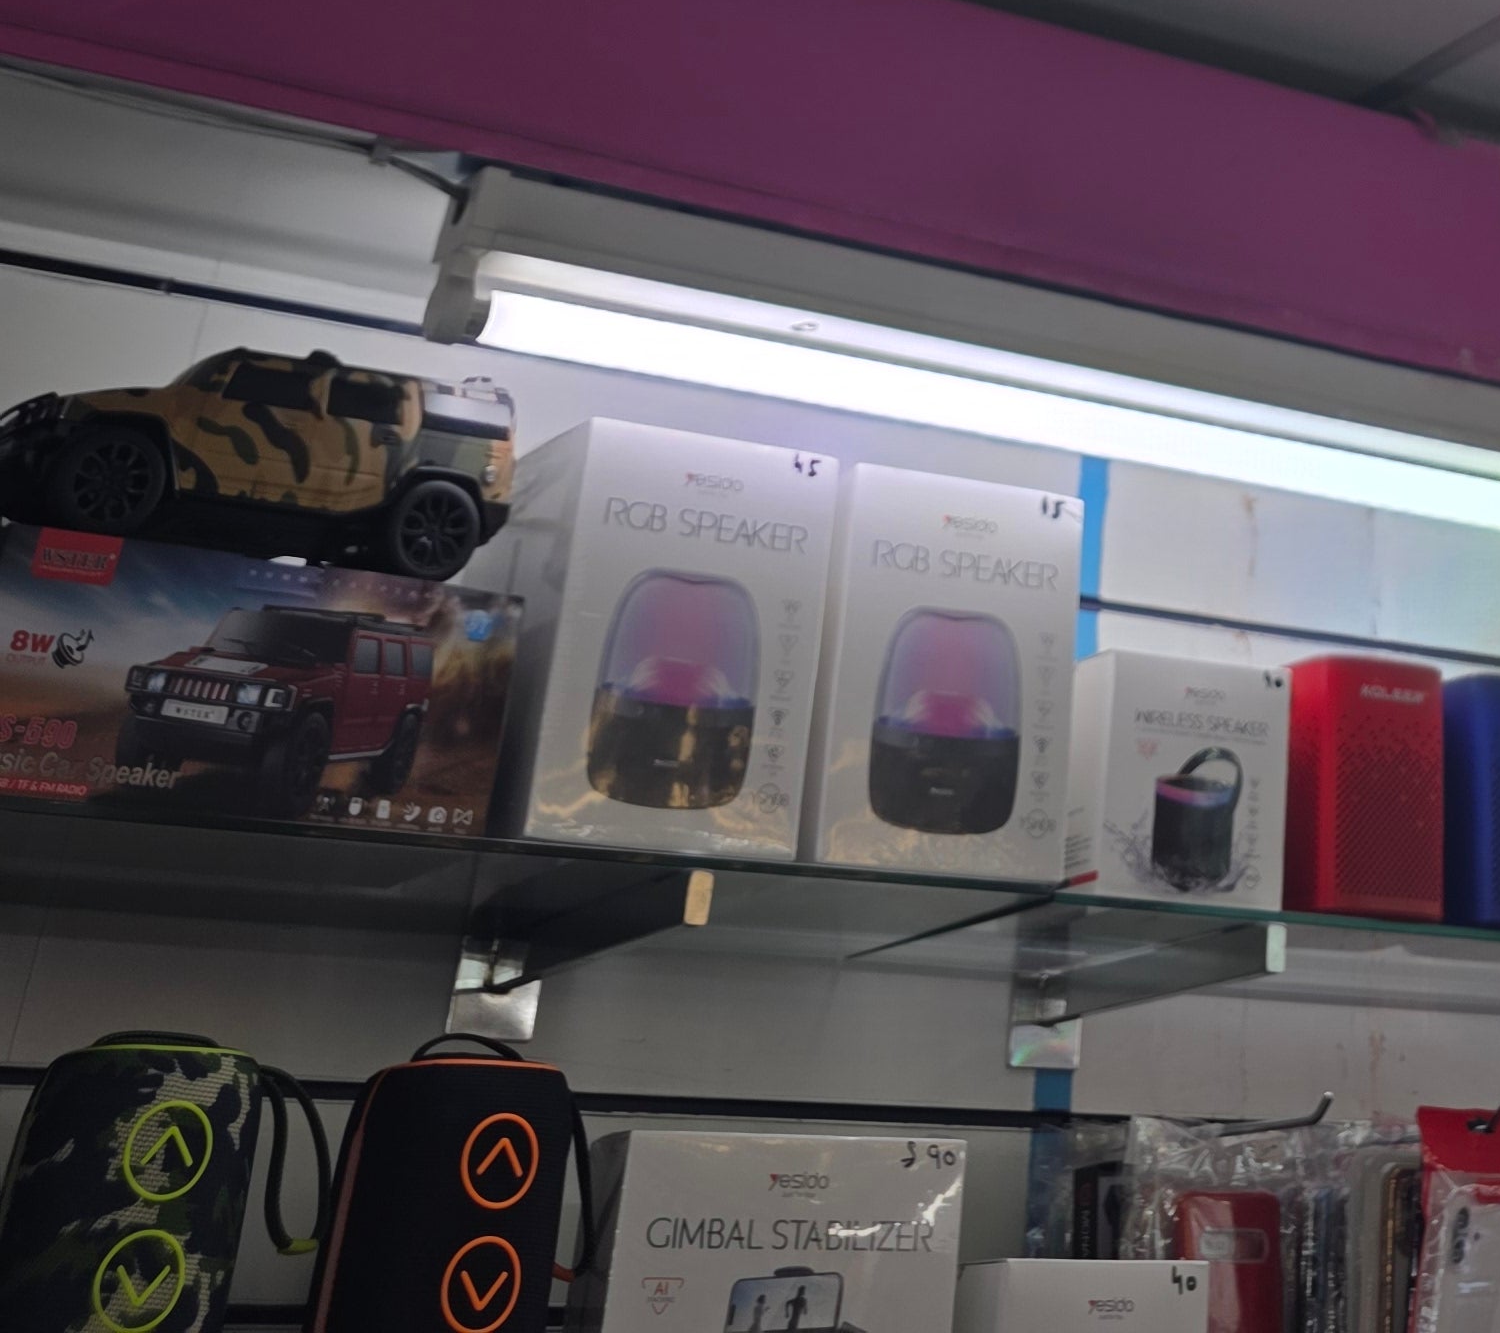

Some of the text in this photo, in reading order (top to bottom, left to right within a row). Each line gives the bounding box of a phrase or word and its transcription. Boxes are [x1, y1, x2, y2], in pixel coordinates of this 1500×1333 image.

[603, 497, 809, 554] RGB SPEAKER
[872, 539, 1060, 590] RGB SPEAKER
[10, 629, 56, 653] 8W
[87, 757, 180, 789] Speaker
[646, 1217, 933, 1252] GIMBAL STABILIZER
